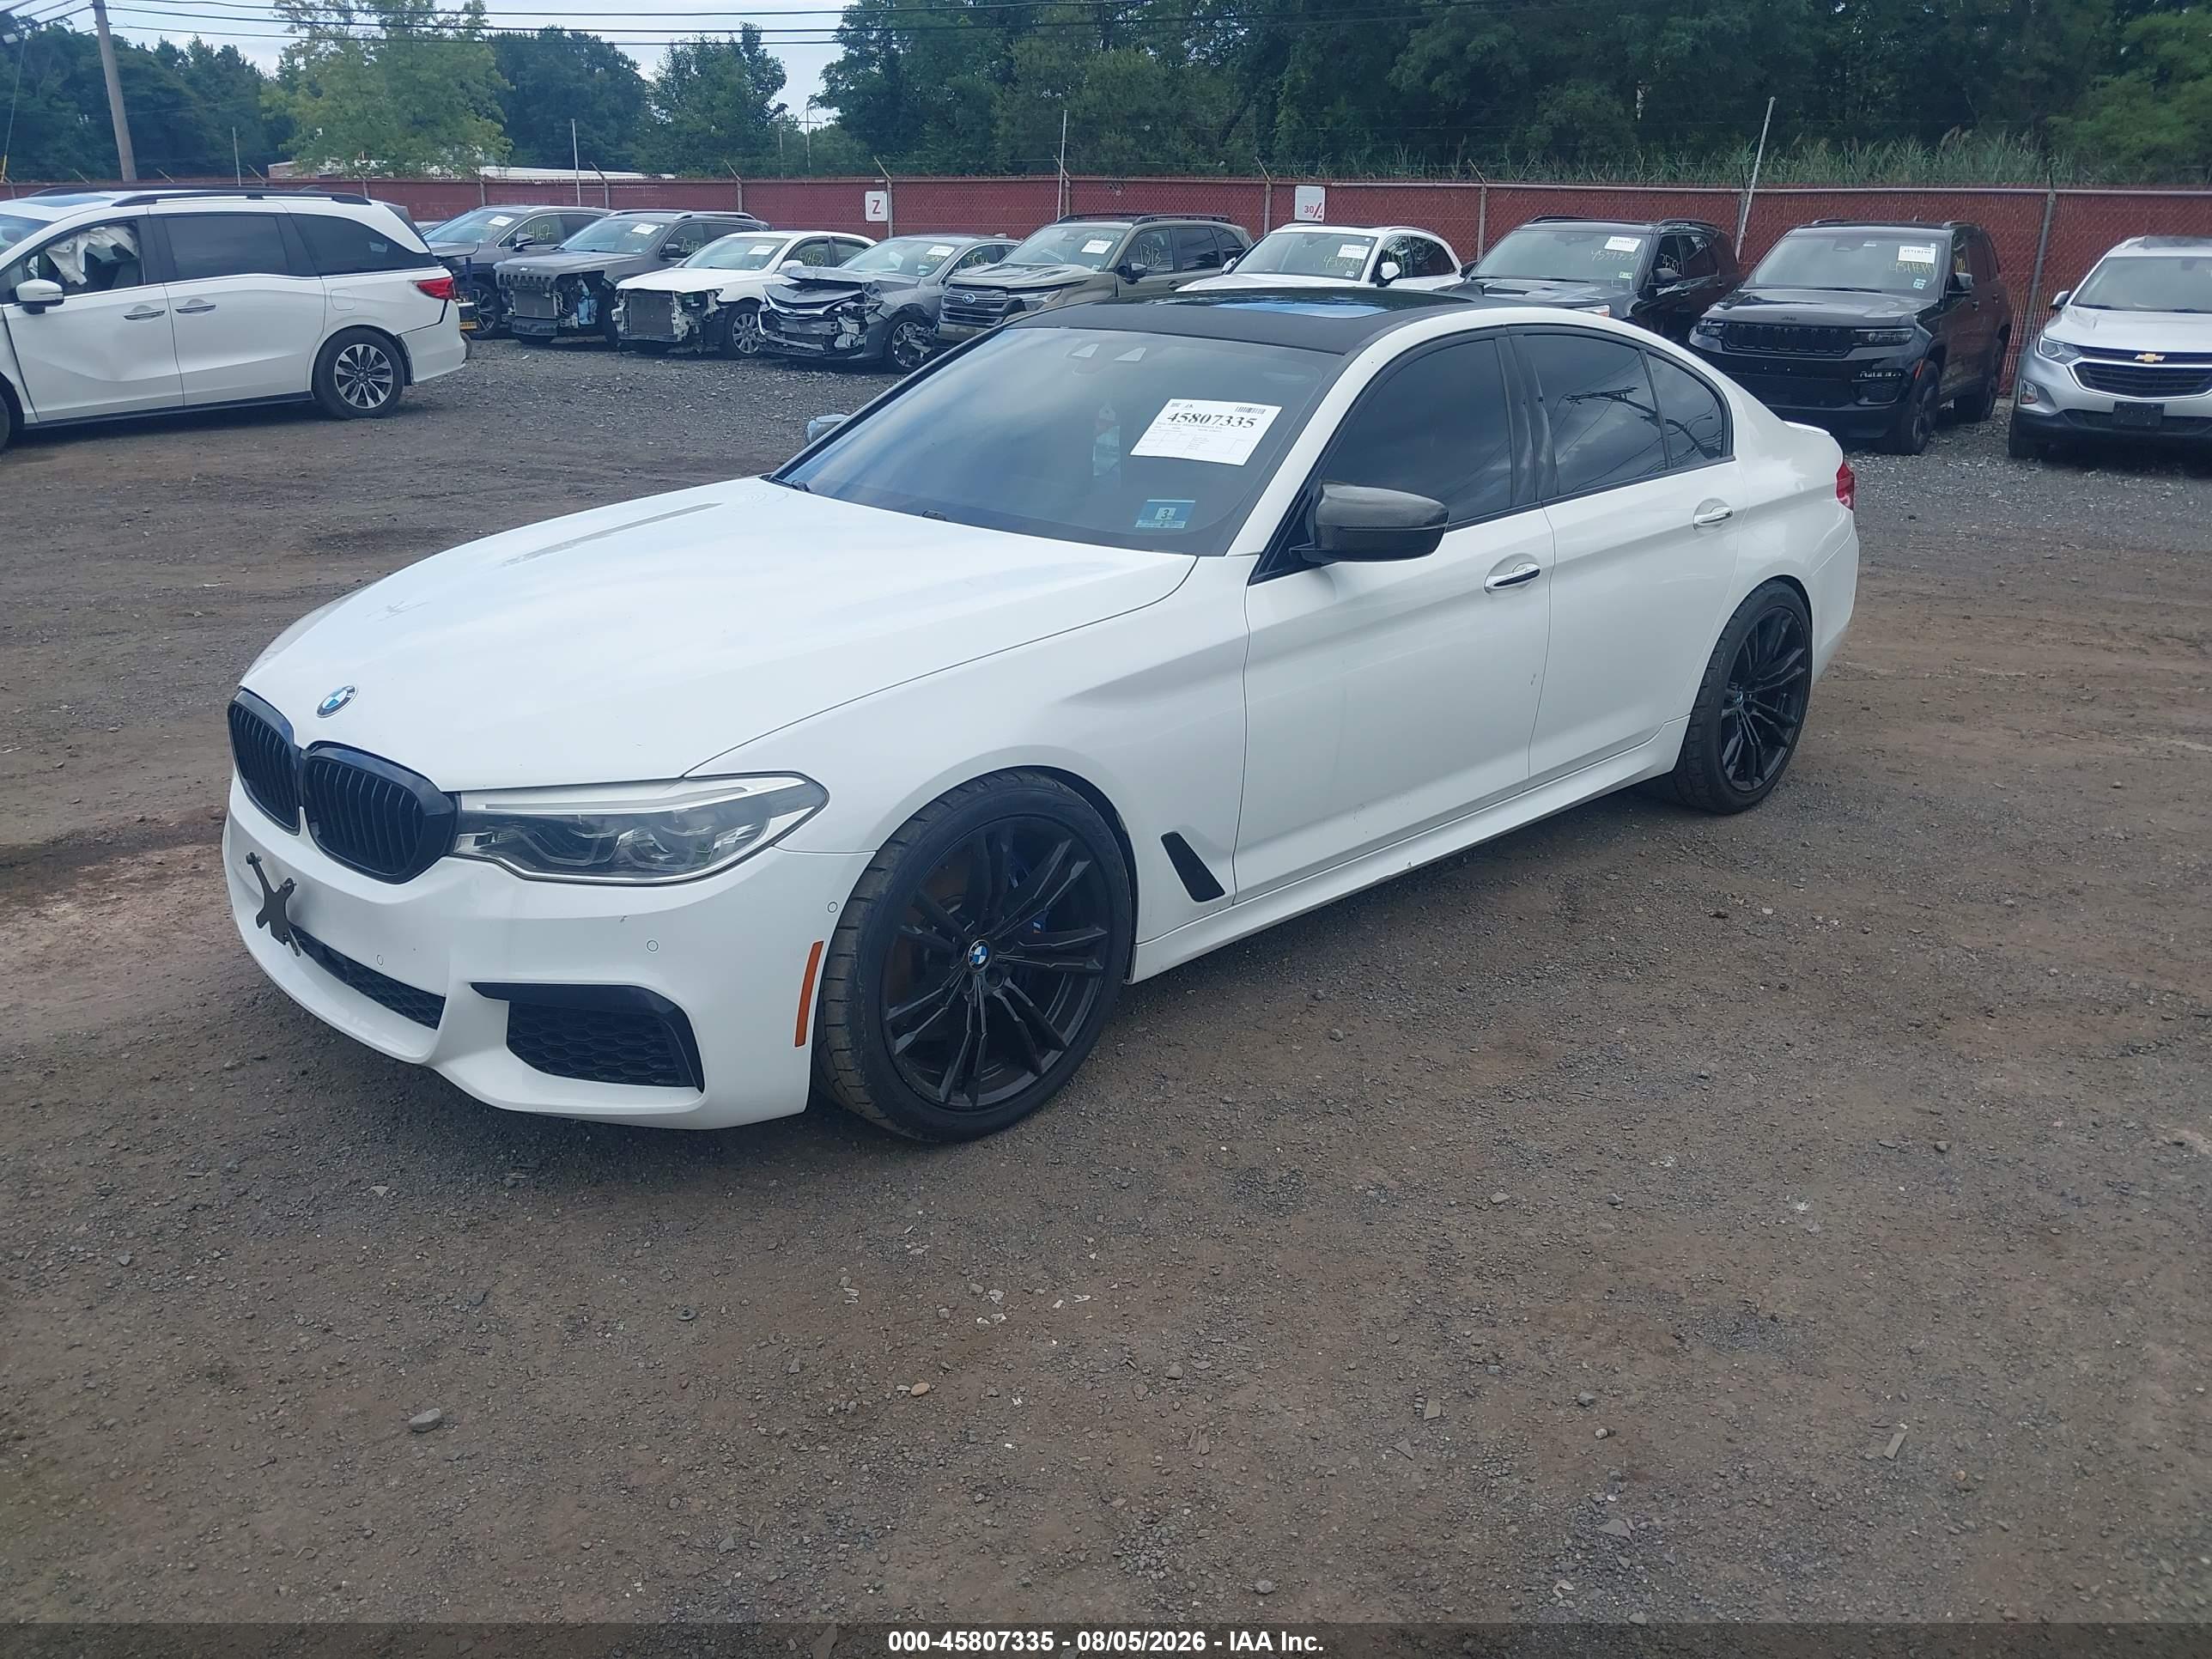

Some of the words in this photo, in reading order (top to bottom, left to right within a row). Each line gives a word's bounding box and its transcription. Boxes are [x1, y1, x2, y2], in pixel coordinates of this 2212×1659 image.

[872, 199, 881, 215] Z
[1167, 412, 1257, 428] 45807335
[1160, 508, 1170, 519] 3
